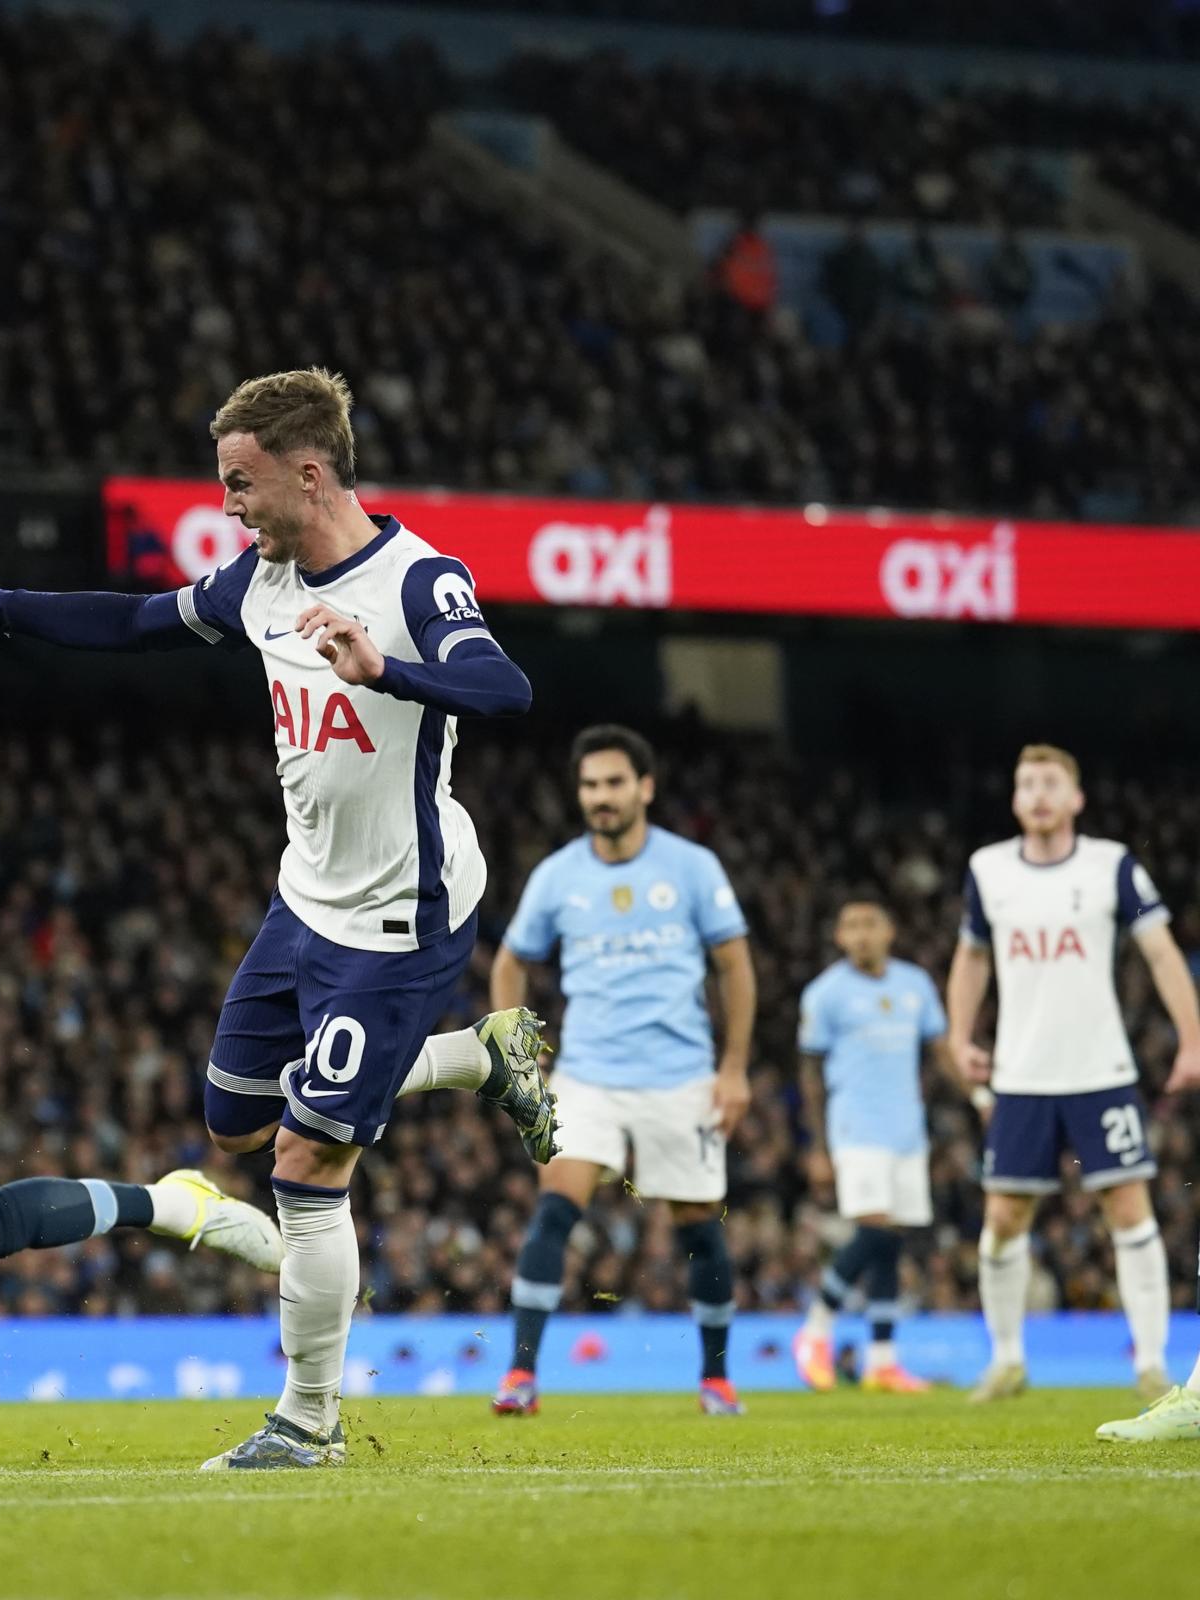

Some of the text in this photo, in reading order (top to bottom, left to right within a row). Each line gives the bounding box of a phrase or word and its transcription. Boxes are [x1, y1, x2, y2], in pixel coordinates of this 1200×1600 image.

[528, 504, 672, 608] axi
[879, 520, 1016, 622] axi
[445, 607, 484, 621] krak
[272, 680, 377, 754] AIA
[1007, 927, 1087, 962] AIA
[1100, 1103, 1142, 1154] 21
